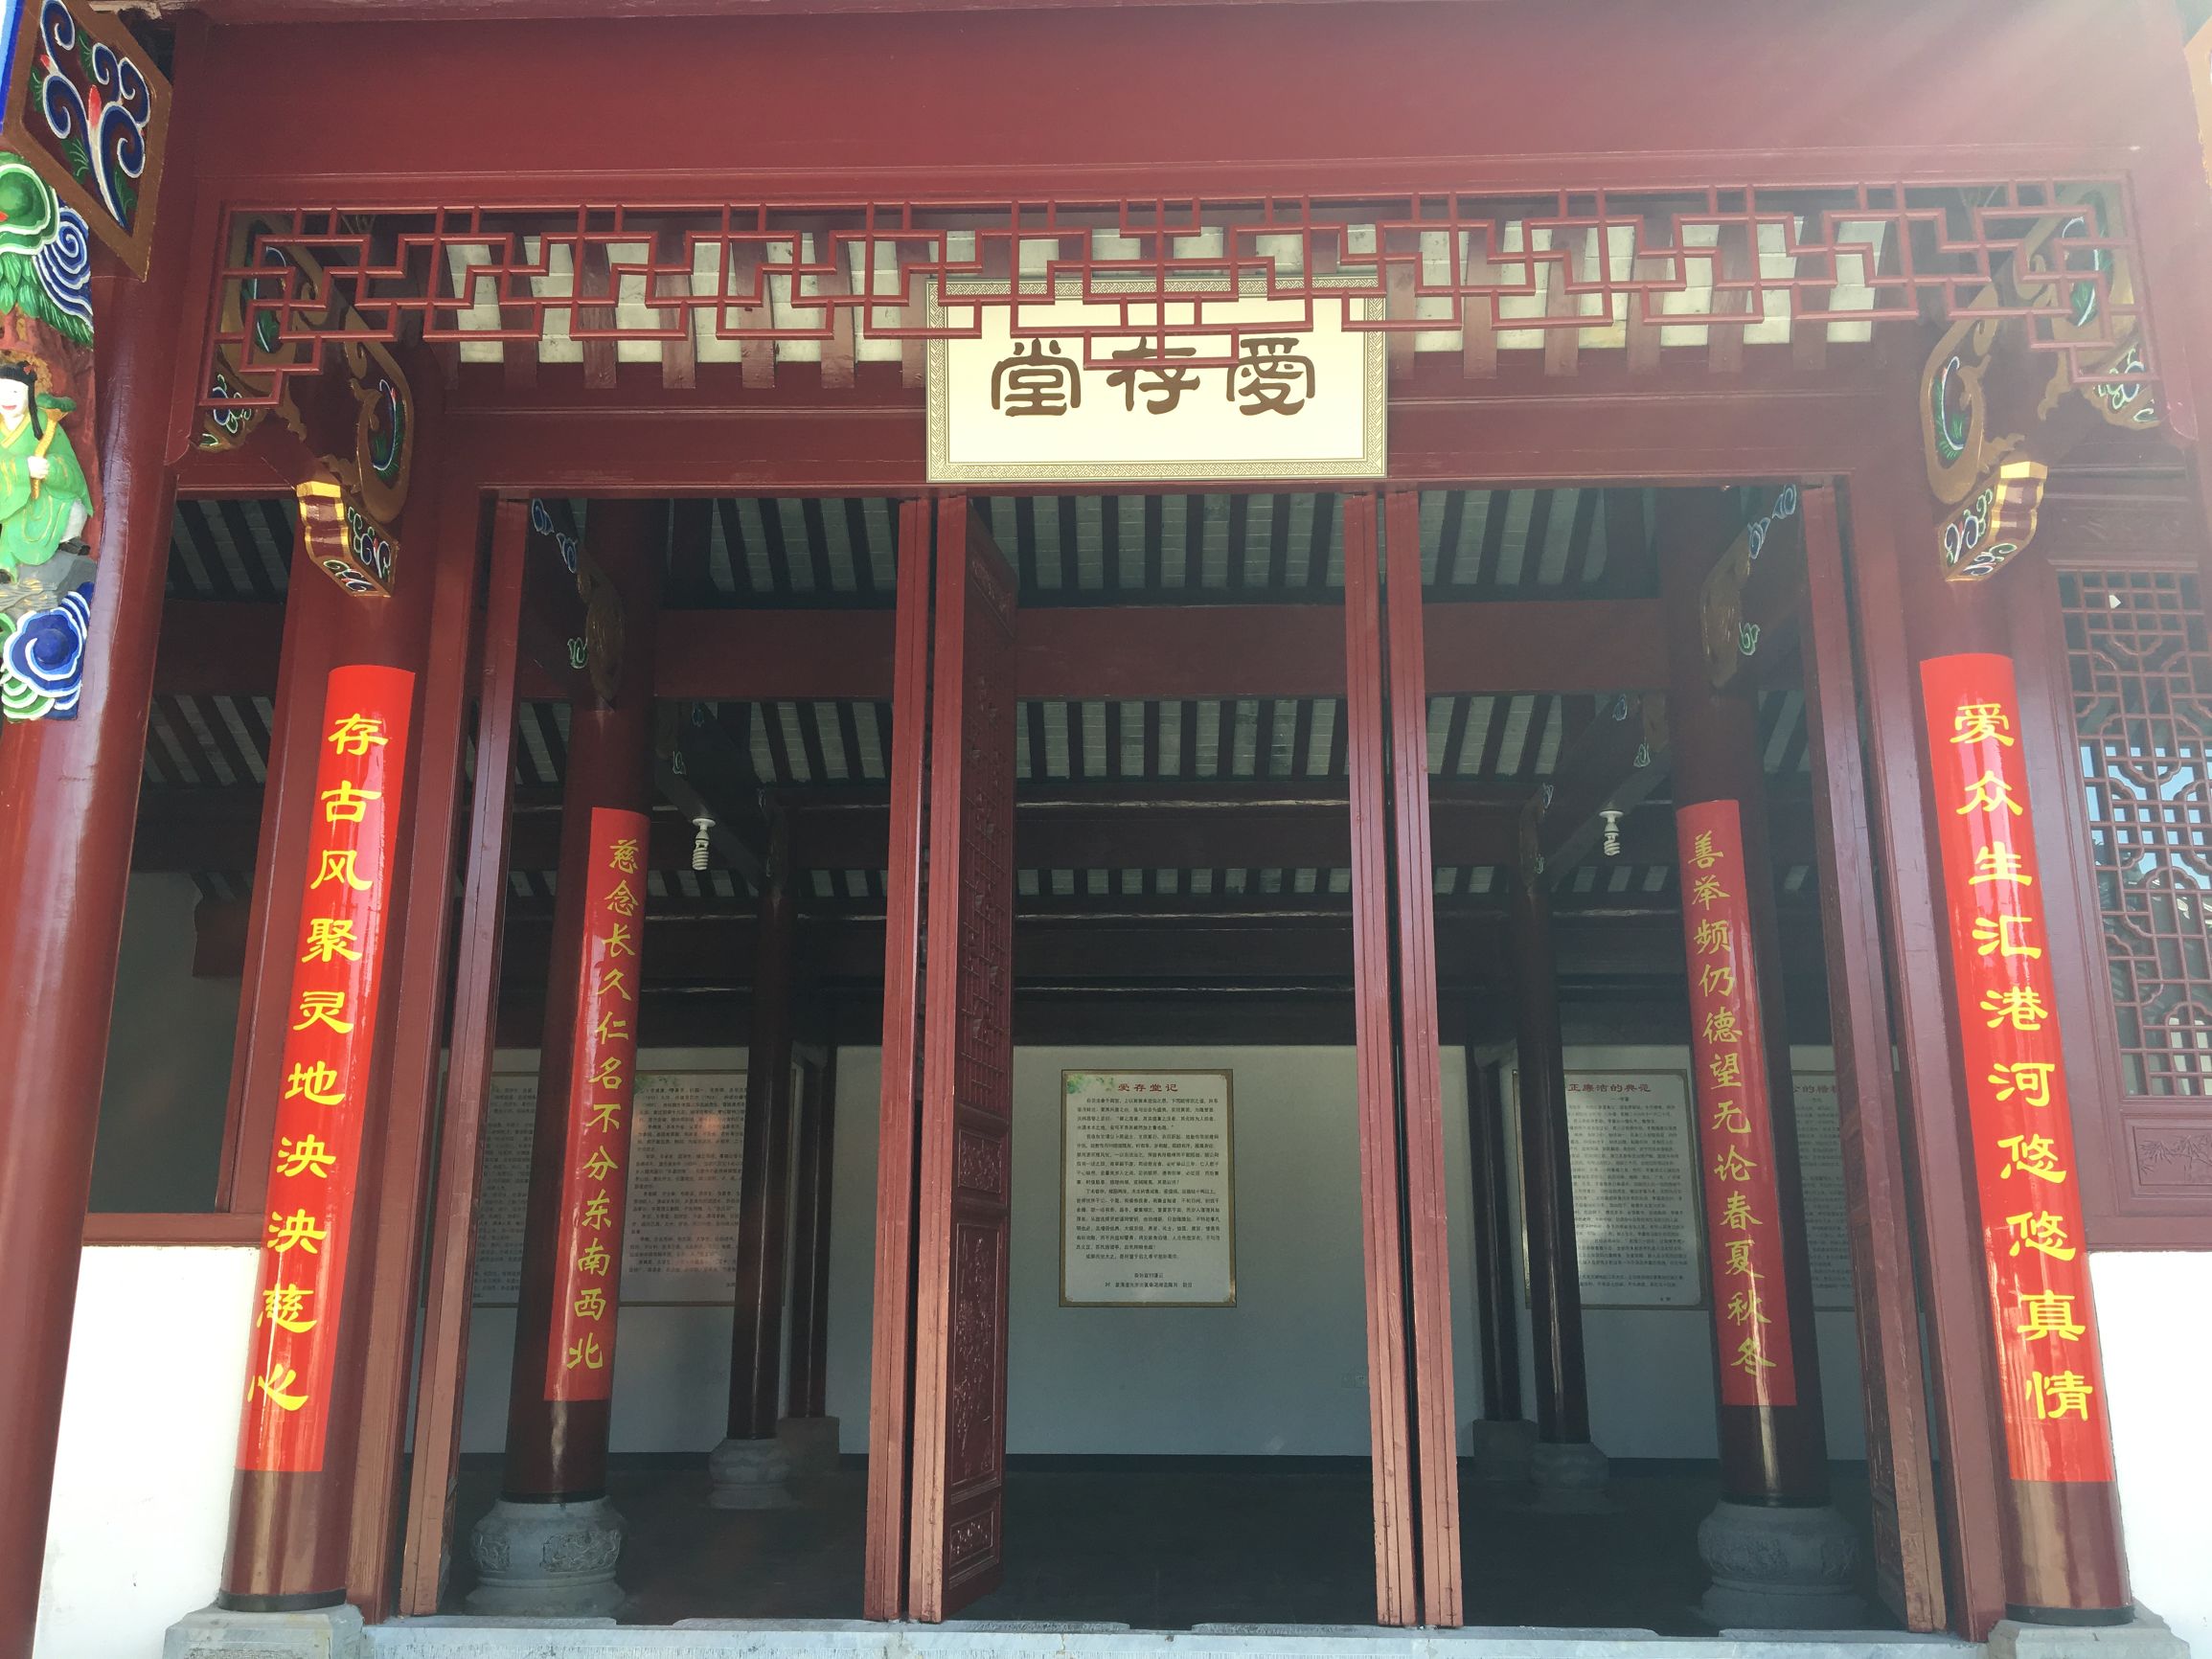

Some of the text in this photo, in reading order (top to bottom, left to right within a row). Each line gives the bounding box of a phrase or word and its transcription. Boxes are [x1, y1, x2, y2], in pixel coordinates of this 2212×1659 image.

[247, 713, 390, 1412] 存古风聚灵地泱泱慈心
[566, 839, 640, 1370] 慈念长久仁名不分东南西北
[1118, 1083, 1179, 1092] 爱存堂记
[1688, 830, 1777, 1376] 善举频仍德望无论春夏秋冬
[1950, 702, 2094, 1421] 爱众生汇港河悠悠真情
